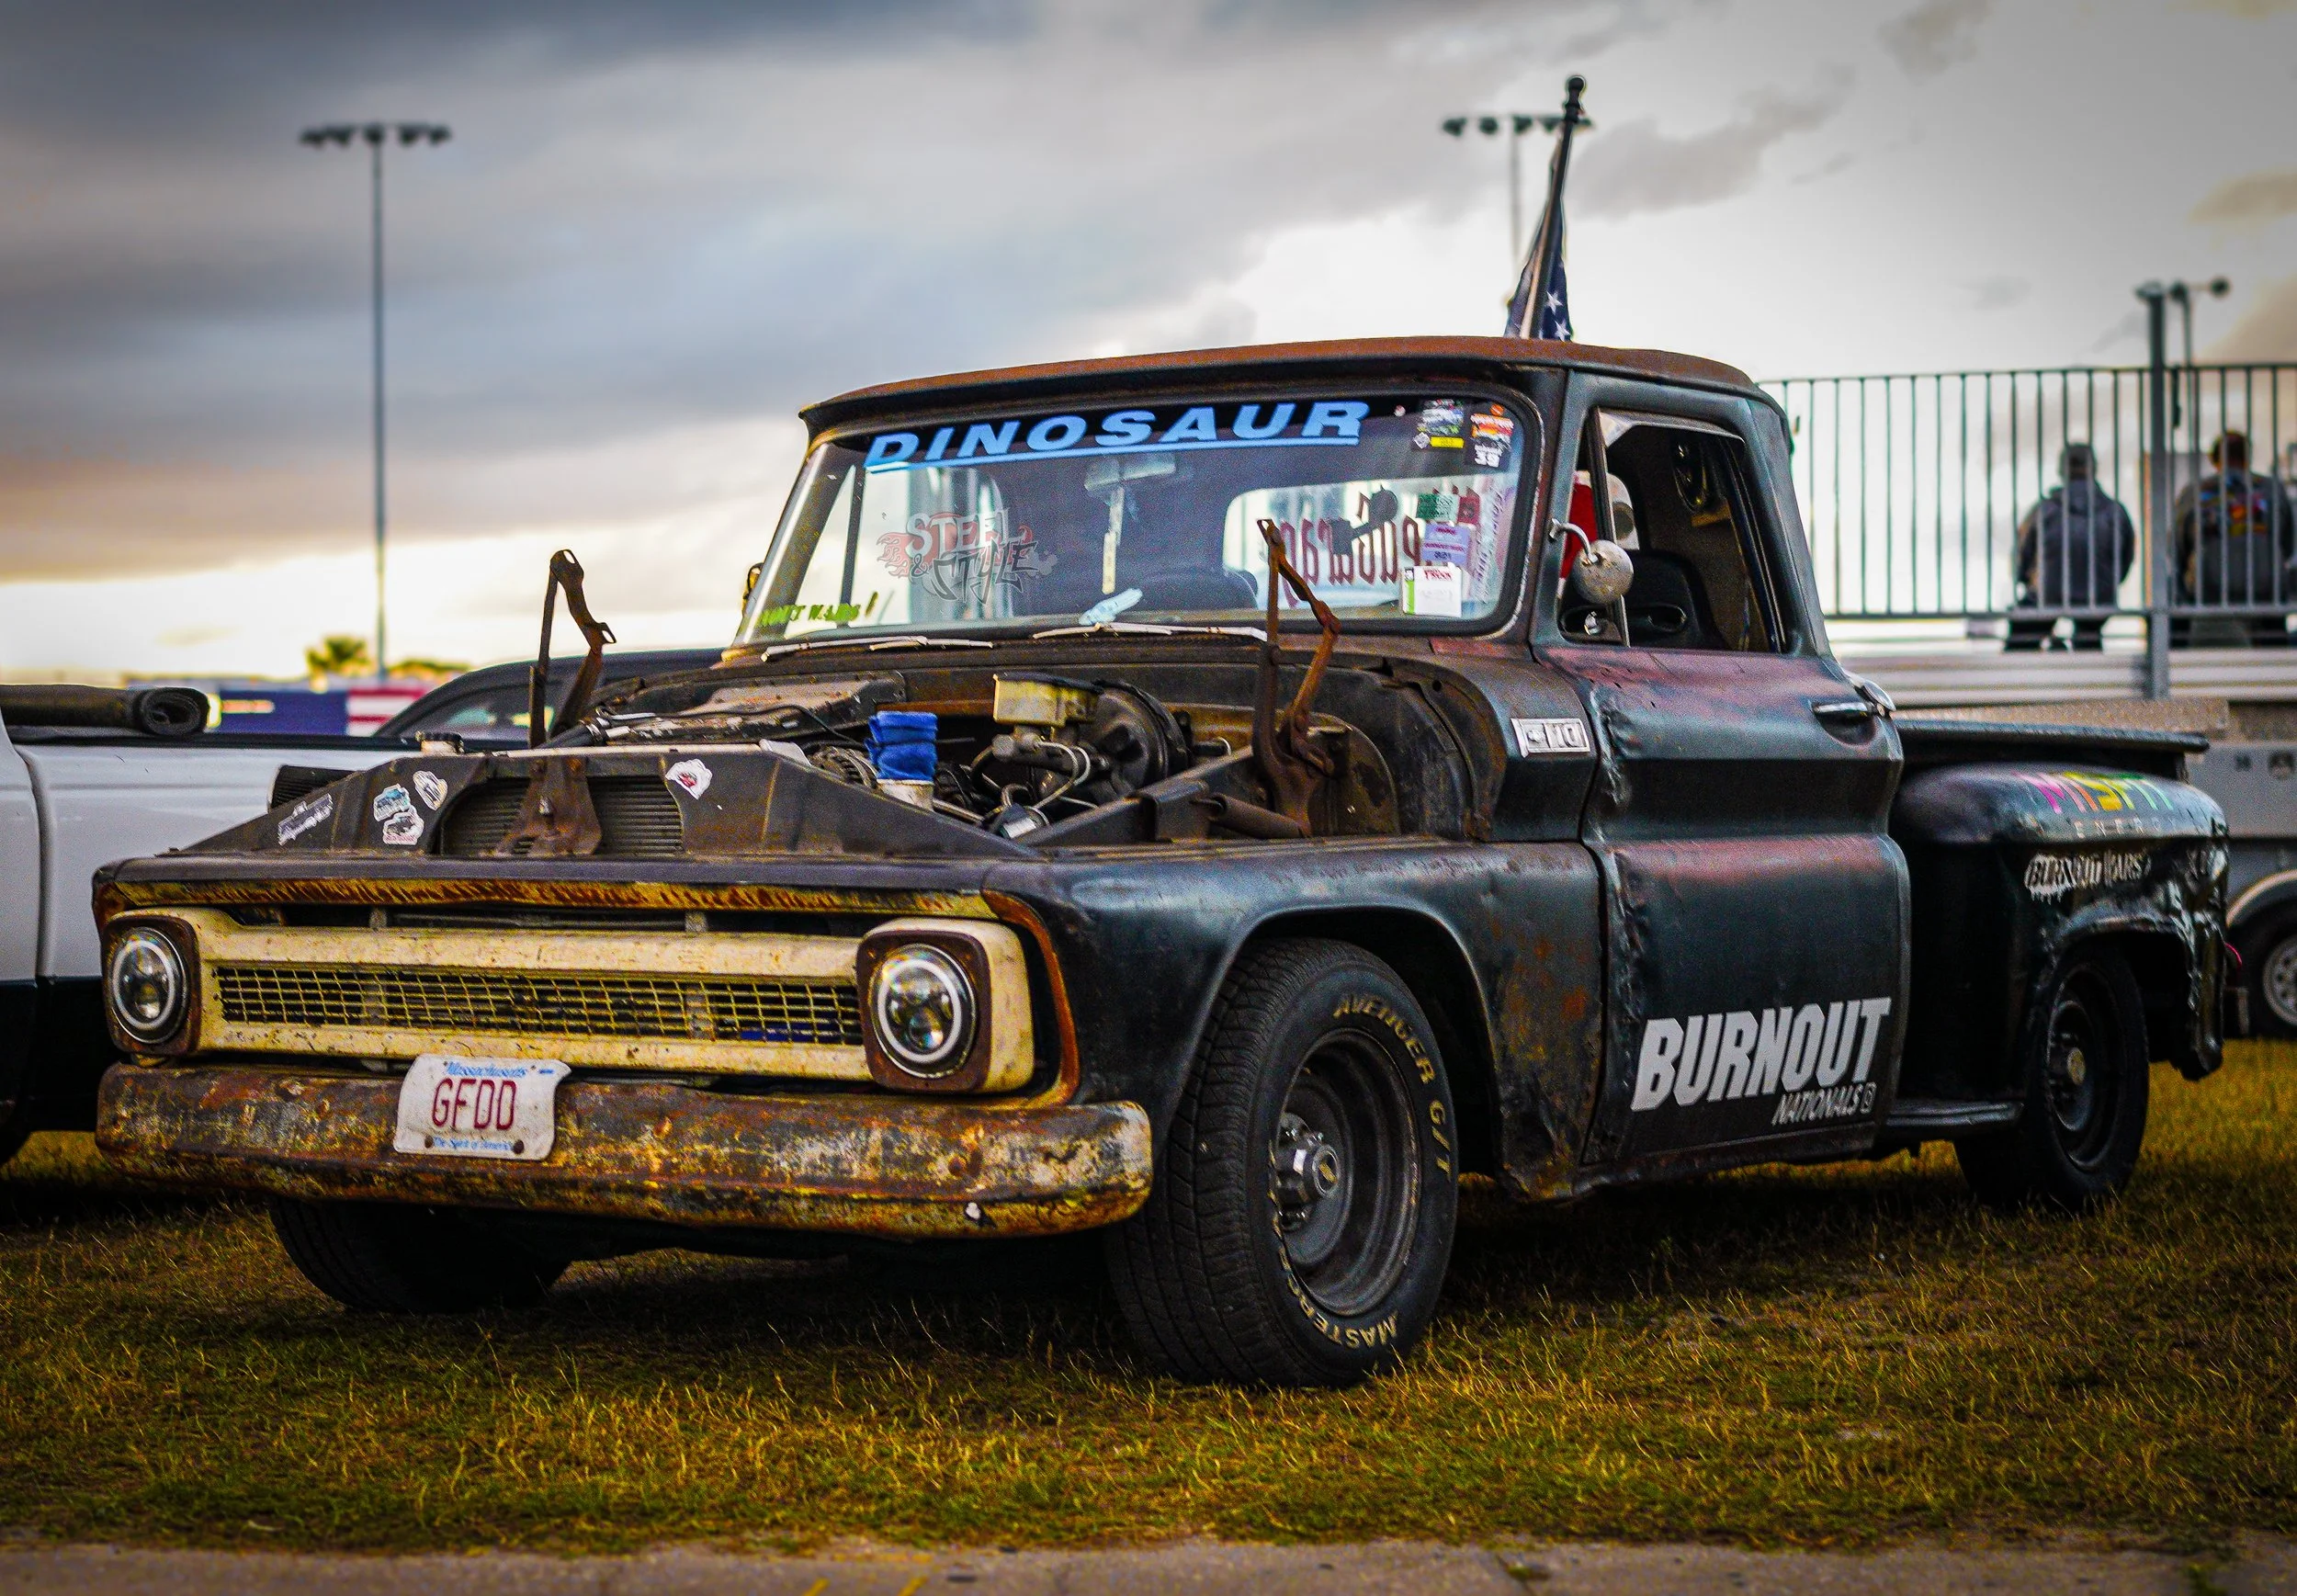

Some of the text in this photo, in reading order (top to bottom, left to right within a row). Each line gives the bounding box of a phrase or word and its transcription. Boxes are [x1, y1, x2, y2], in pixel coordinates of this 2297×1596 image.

[864, 402, 1370, 468] DINOSAUR
[905, 508, 1009, 559] STEEL
[911, 553, 930, 578] &
[447, 1061, 527, 1078] Massachusetts
[1630, 996, 1892, 1112] BURNOUT
[432, 1078, 516, 1131] GFDD
[1771, 1083, 1858, 1126] NATIONALS
